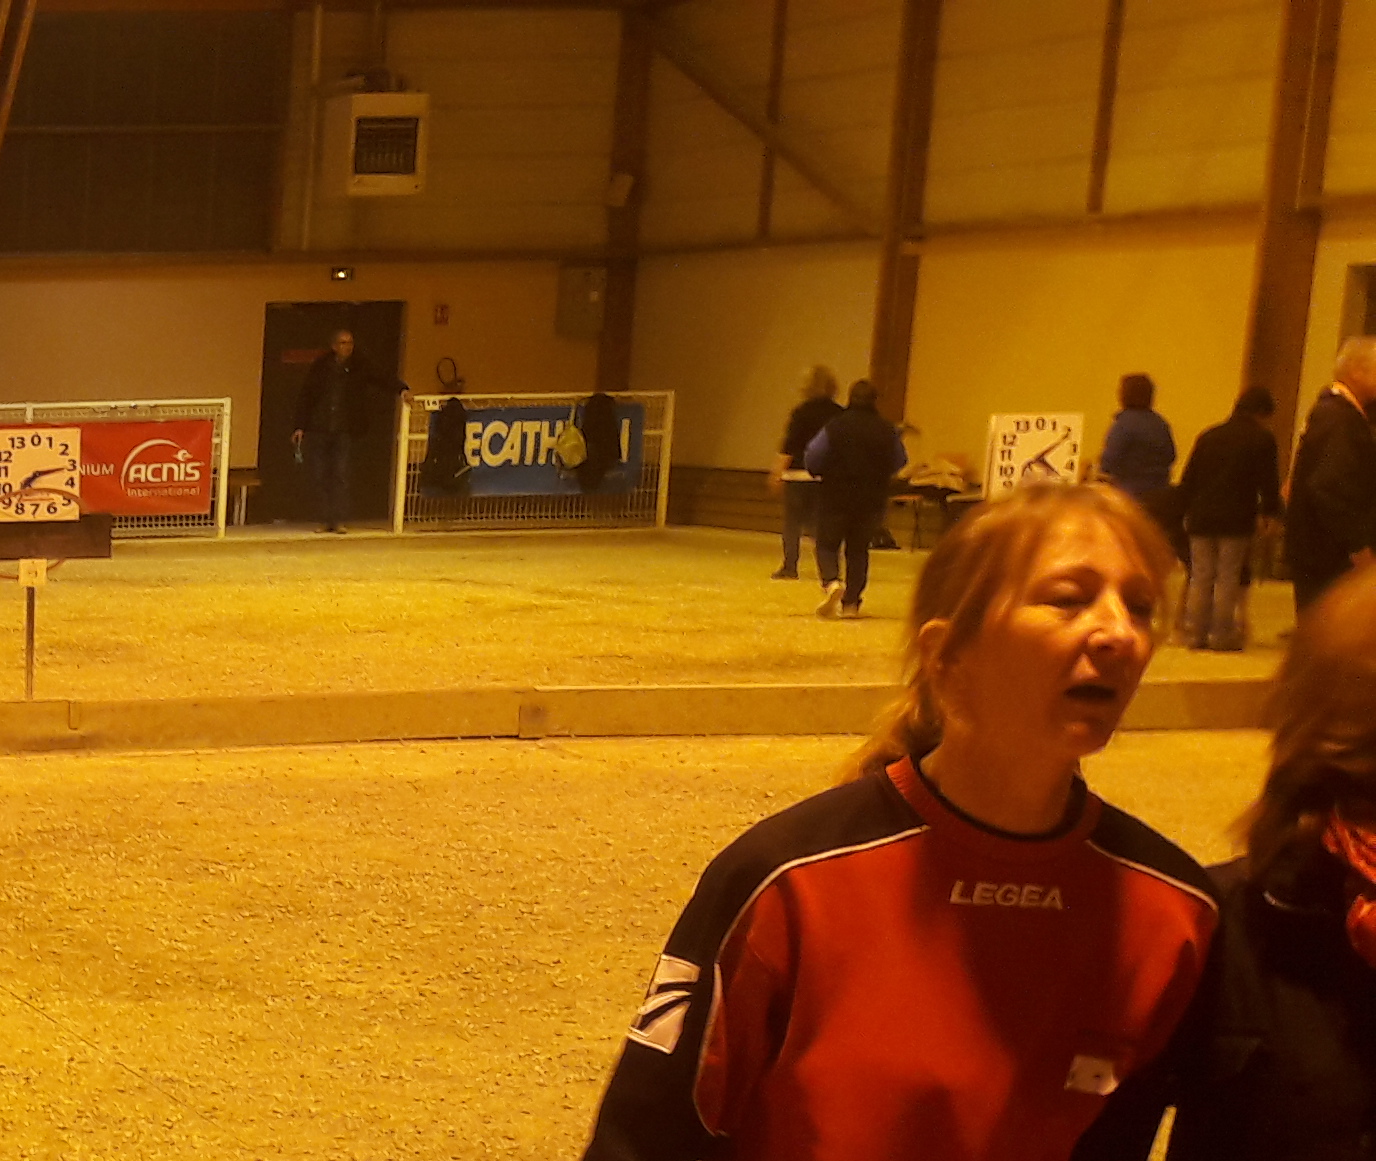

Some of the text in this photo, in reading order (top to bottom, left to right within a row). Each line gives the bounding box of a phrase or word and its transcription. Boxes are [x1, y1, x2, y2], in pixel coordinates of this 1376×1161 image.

[8, 436, 26, 450] 13
[30, 434, 42, 447] 0
[46, 437, 54, 450] 1
[464, 418, 631, 467] ECATH
[59, 443, 70, 457] 2
[66, 459, 77, 472] 3
[64, 477, 76, 489] 4
[14, 503, 26, 516] 8
[30, 503, 40, 516] 7
[46, 502, 58, 515] 6
[949, 880, 1064, 910] LEGEA
